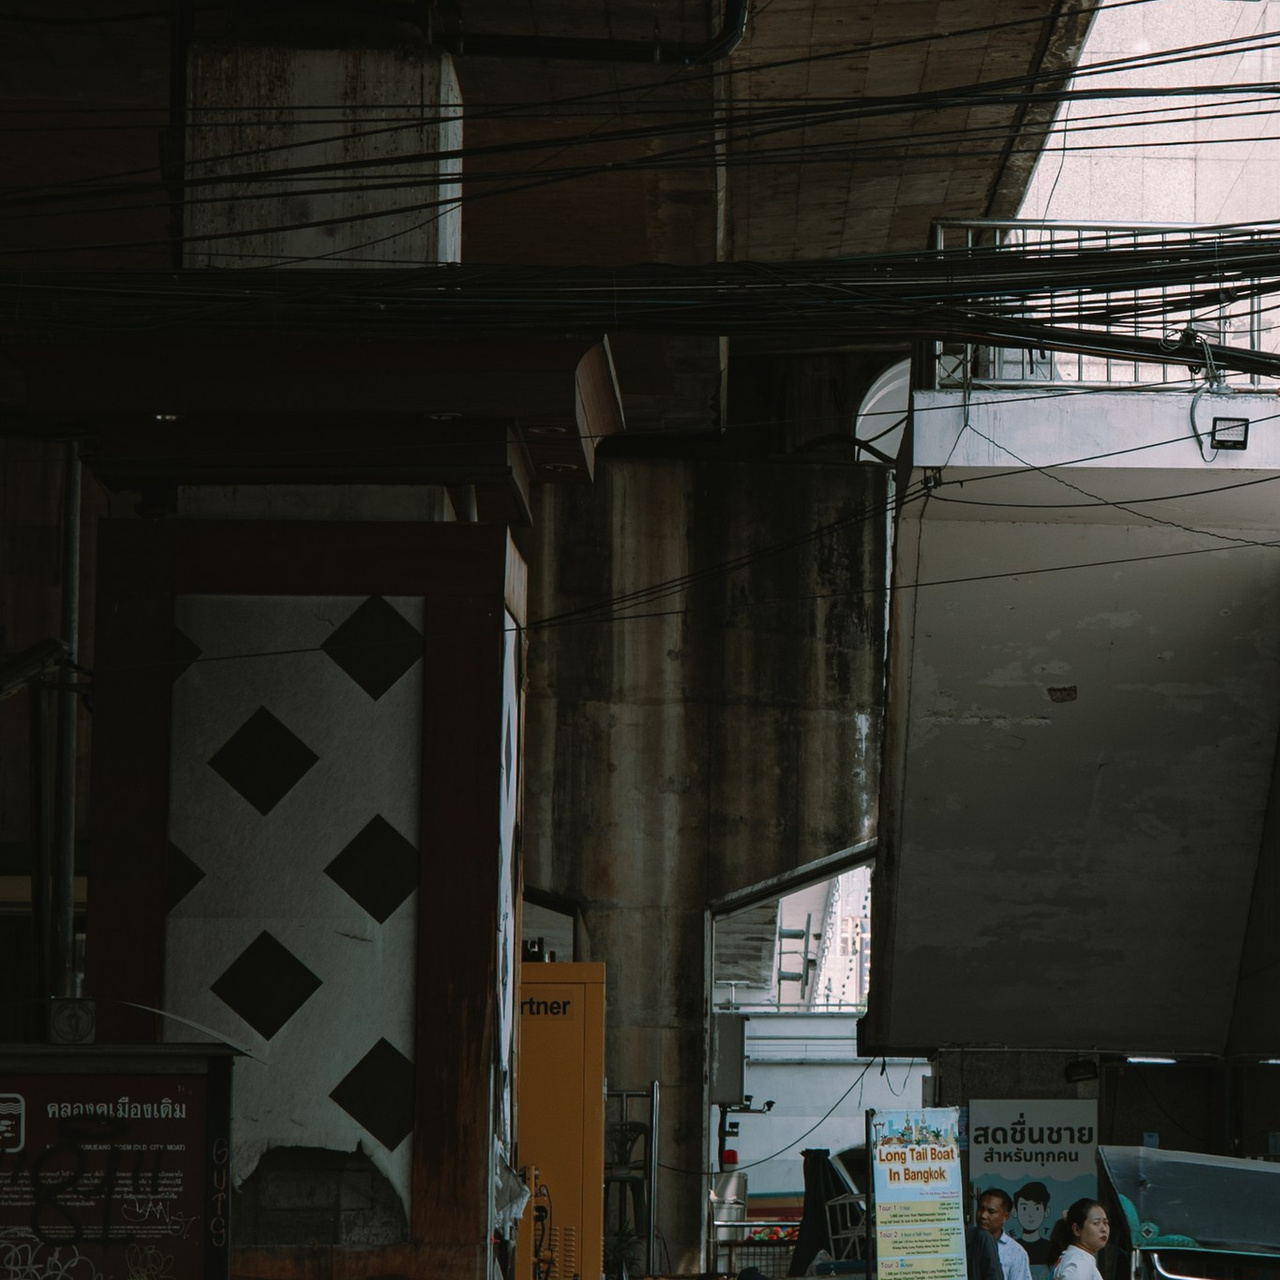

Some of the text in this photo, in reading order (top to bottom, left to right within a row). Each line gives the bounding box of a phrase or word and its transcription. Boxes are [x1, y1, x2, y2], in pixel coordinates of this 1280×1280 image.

[47, 1096, 187, 1119] คลองคเมืองเดิม
[972, 1112, 1094, 1145] สดชื่นชาย
[879, 1147, 955, 1164] Long Tail Boat
[983, 1147, 1079, 1168] สำหรับทุกคน
[889, 1167, 946, 1183] In Bangkok
